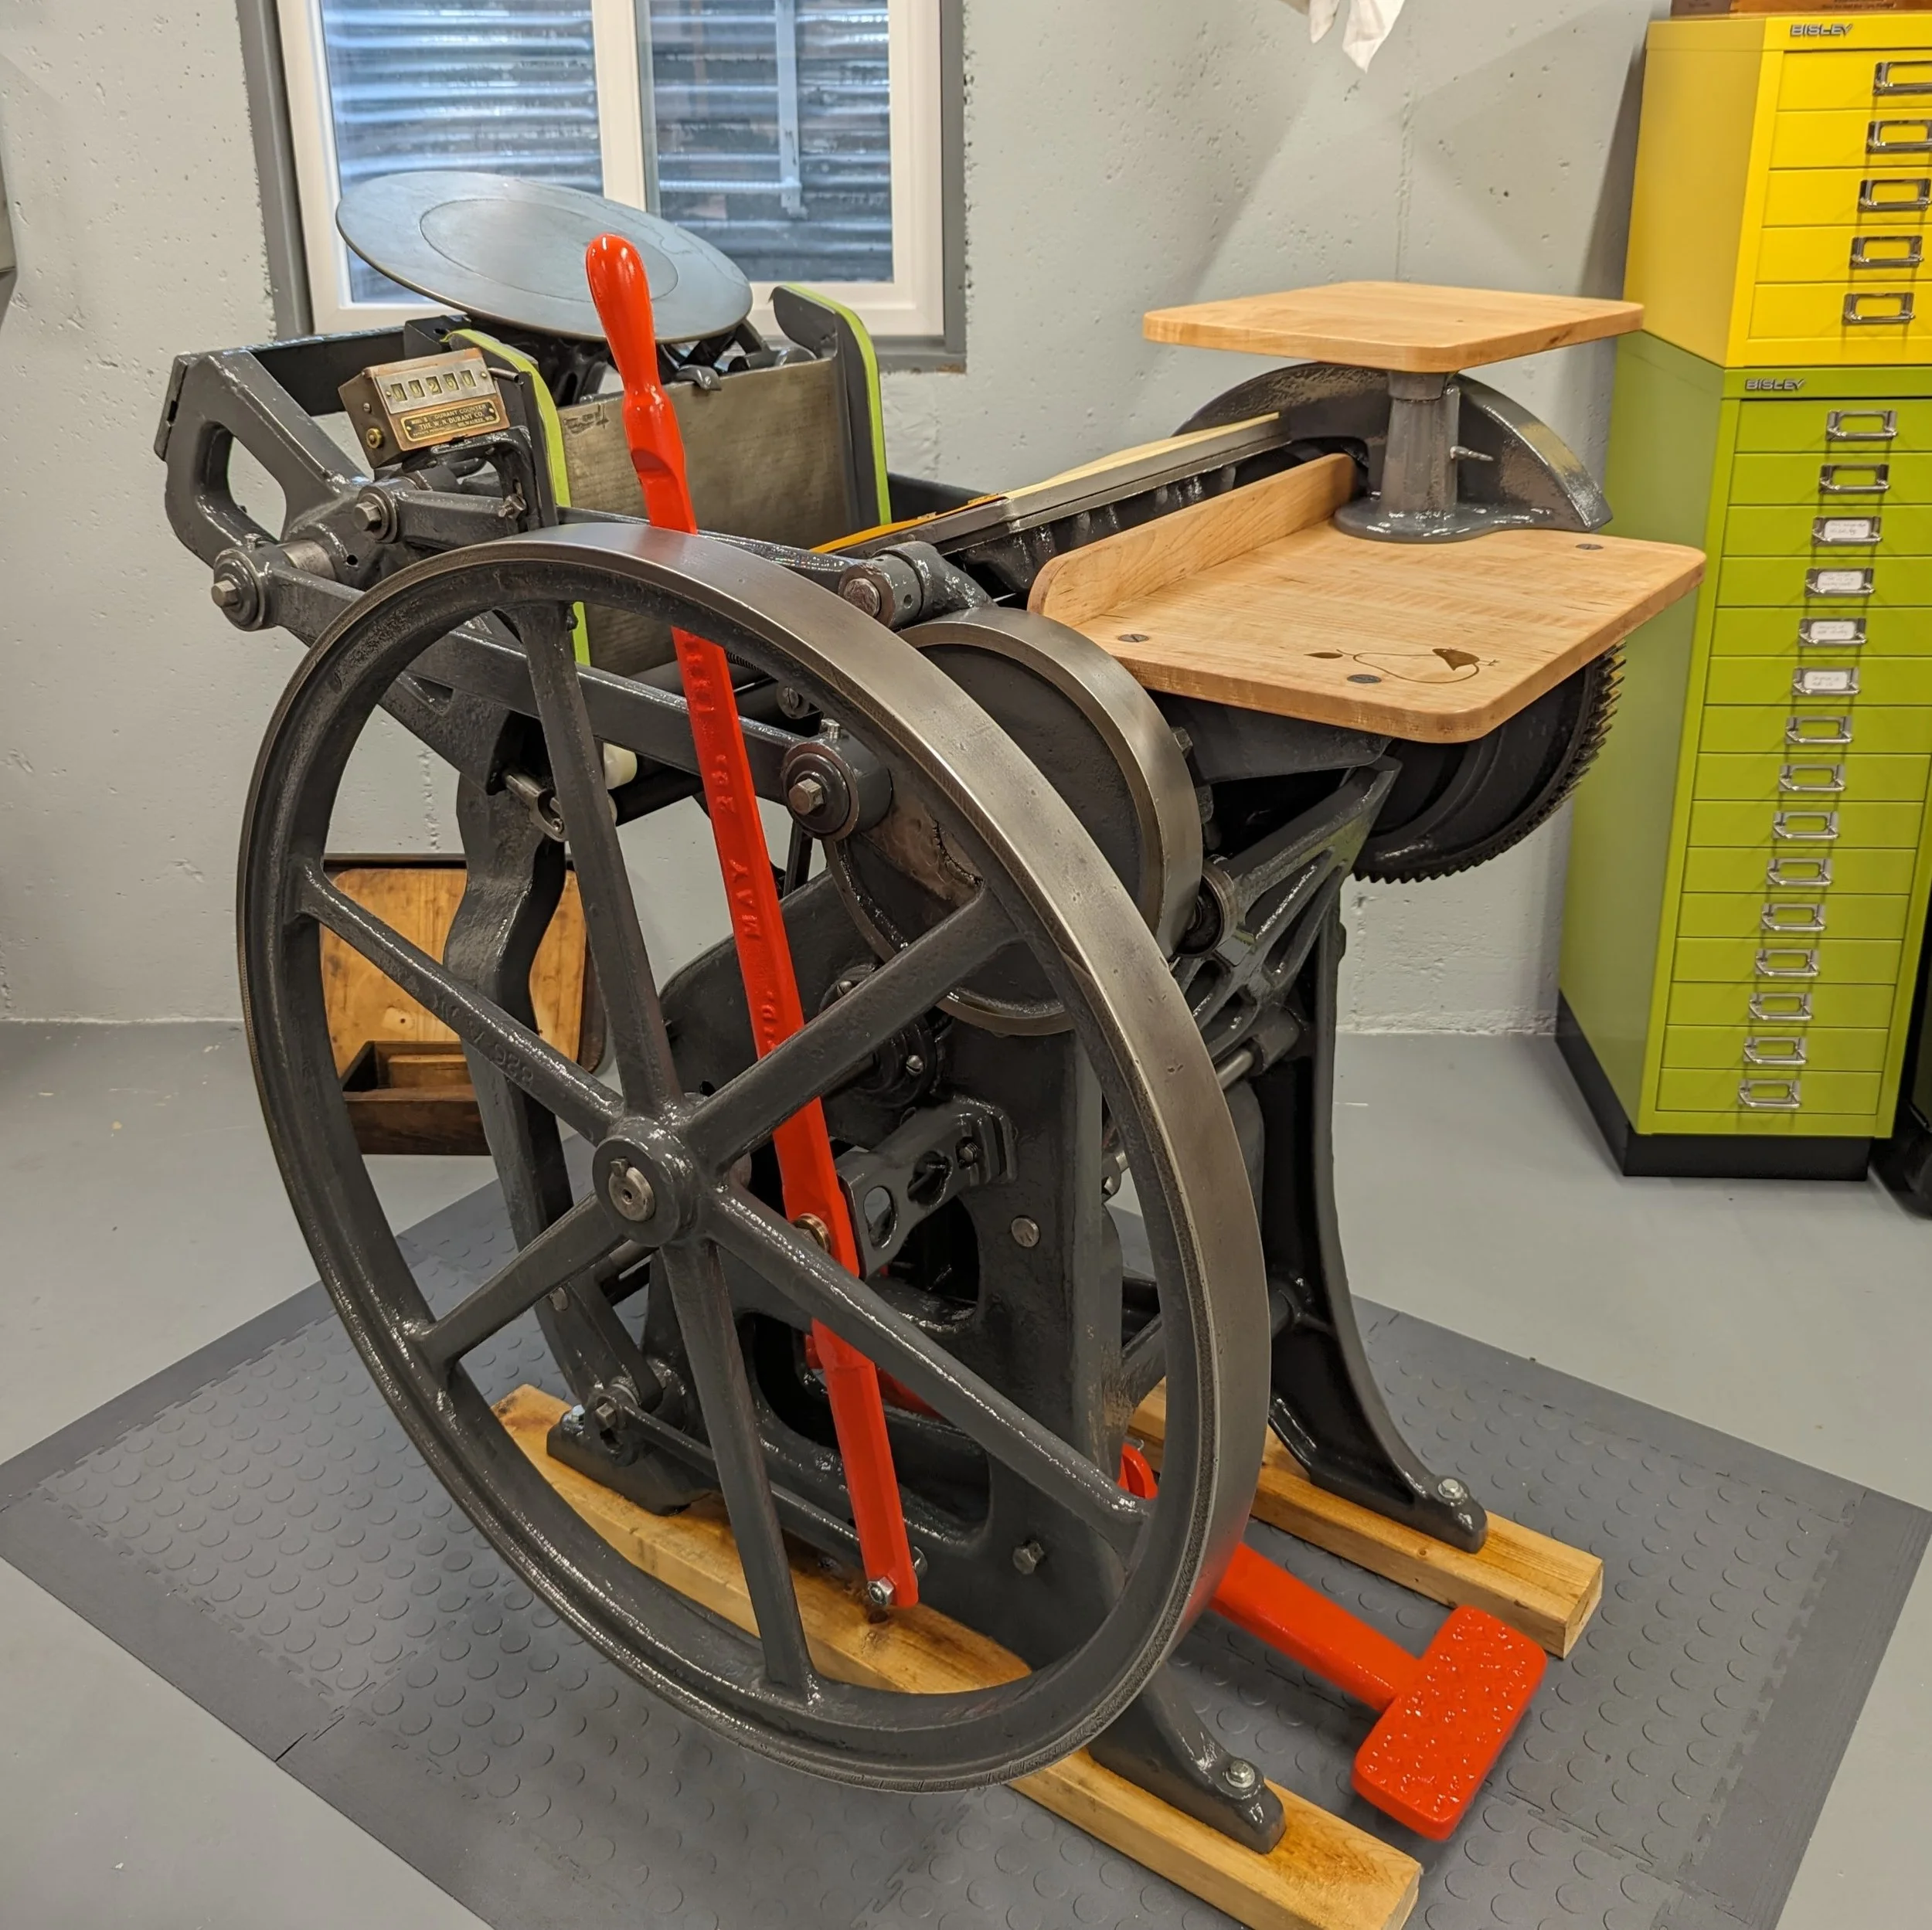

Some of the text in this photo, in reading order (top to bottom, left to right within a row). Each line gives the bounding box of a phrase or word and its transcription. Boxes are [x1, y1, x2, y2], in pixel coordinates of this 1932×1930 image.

[1790, 22, 1853, 37] BISLEY
[1745, 378, 1805, 390] BISLEY
[434, 409, 458, 420] DURANT
[459, 404, 487, 414] COUNTER
[449, 413, 473, 424] DURANT
[730, 859, 760, 939] MAY
